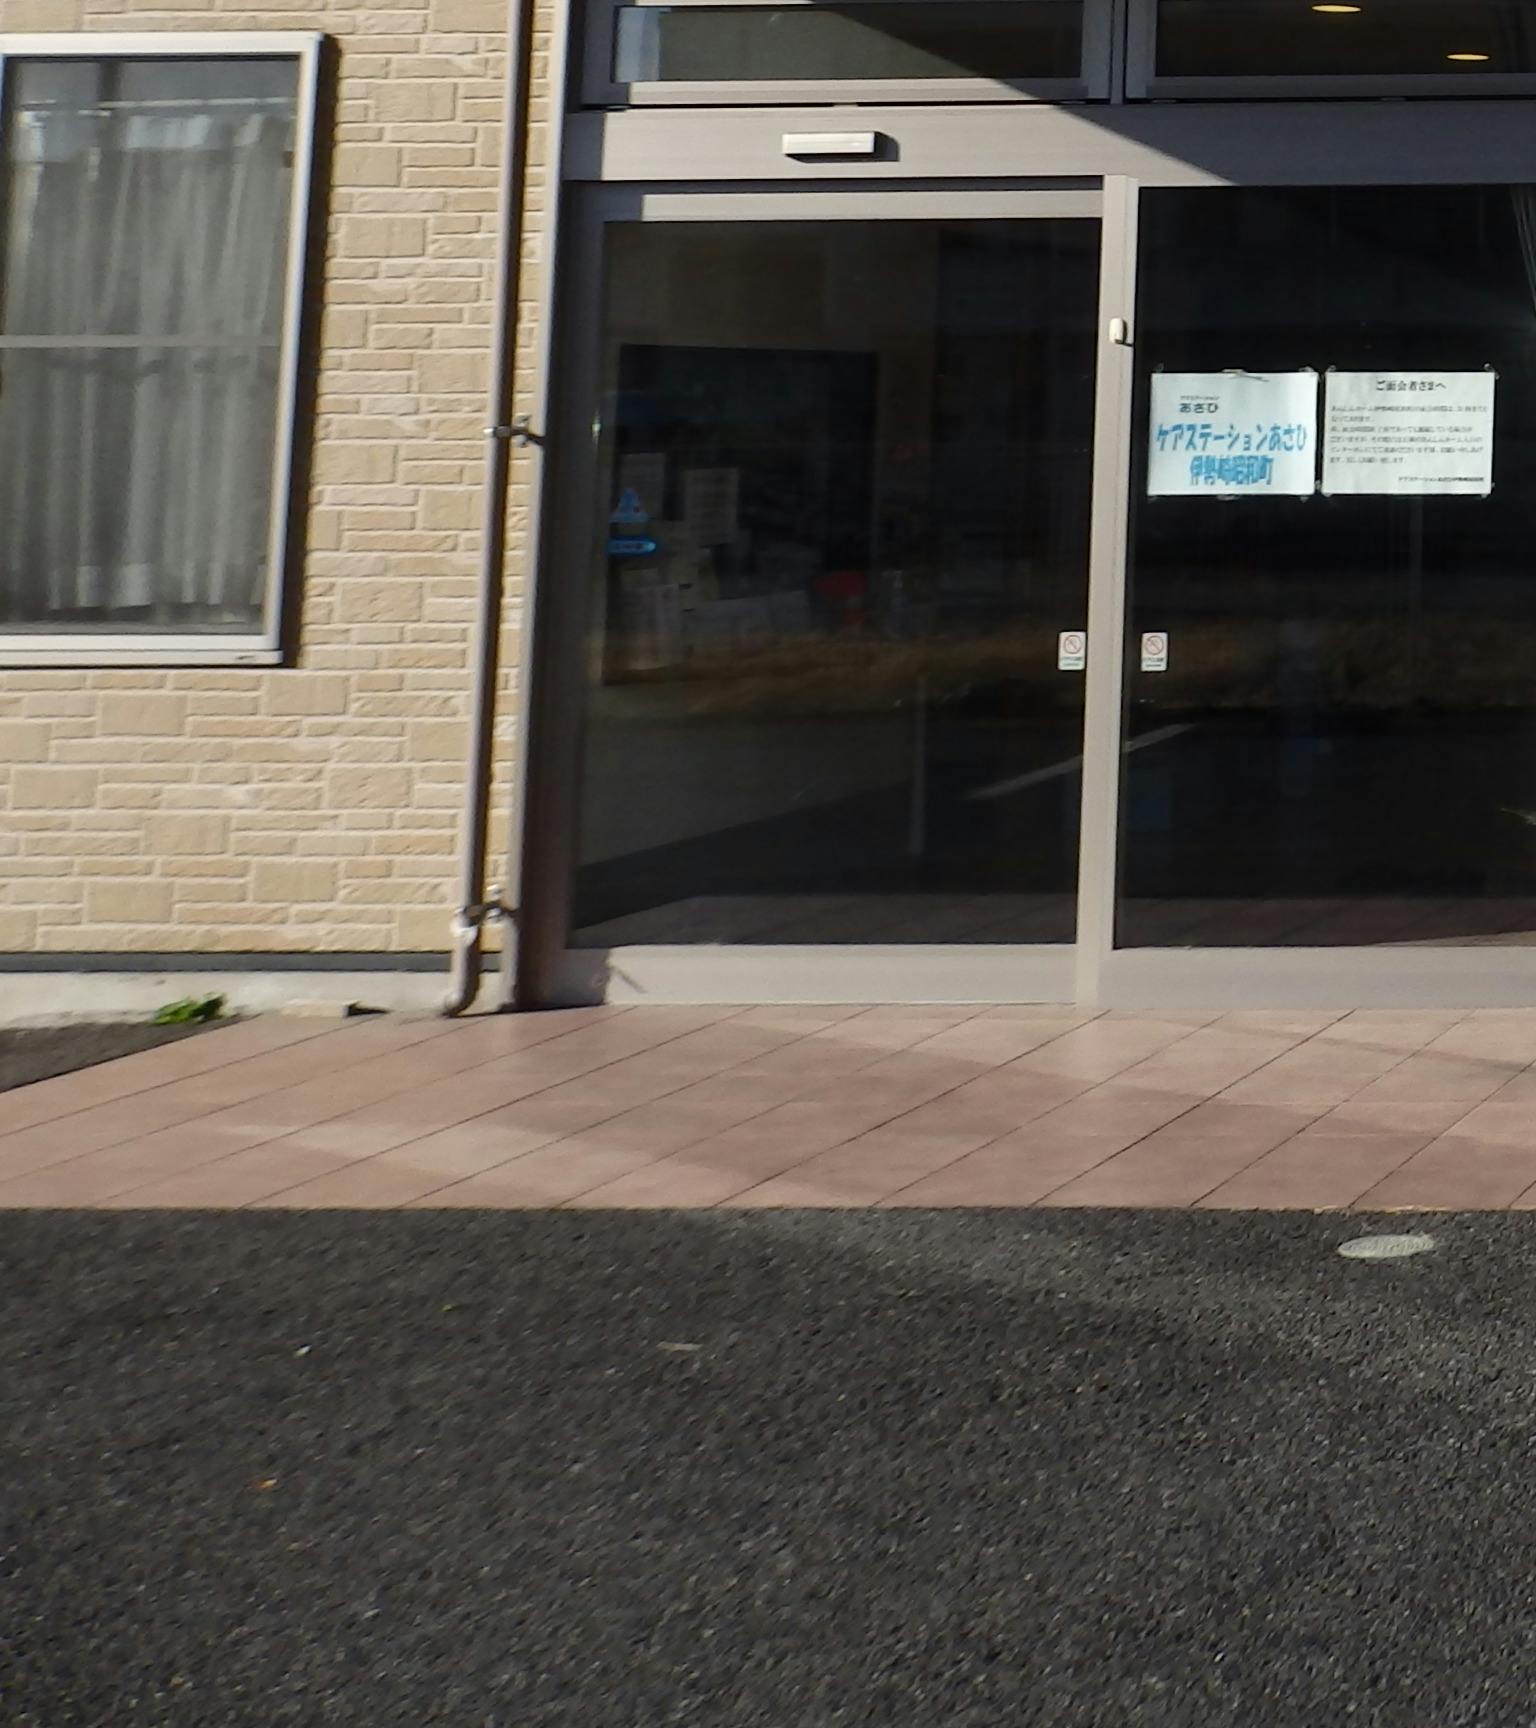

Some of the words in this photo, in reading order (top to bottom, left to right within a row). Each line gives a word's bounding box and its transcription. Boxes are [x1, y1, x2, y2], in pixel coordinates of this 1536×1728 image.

[1179, 402, 1220, 414] あさひ
[1156, 423, 1308, 451] ケアステーションあさひ
